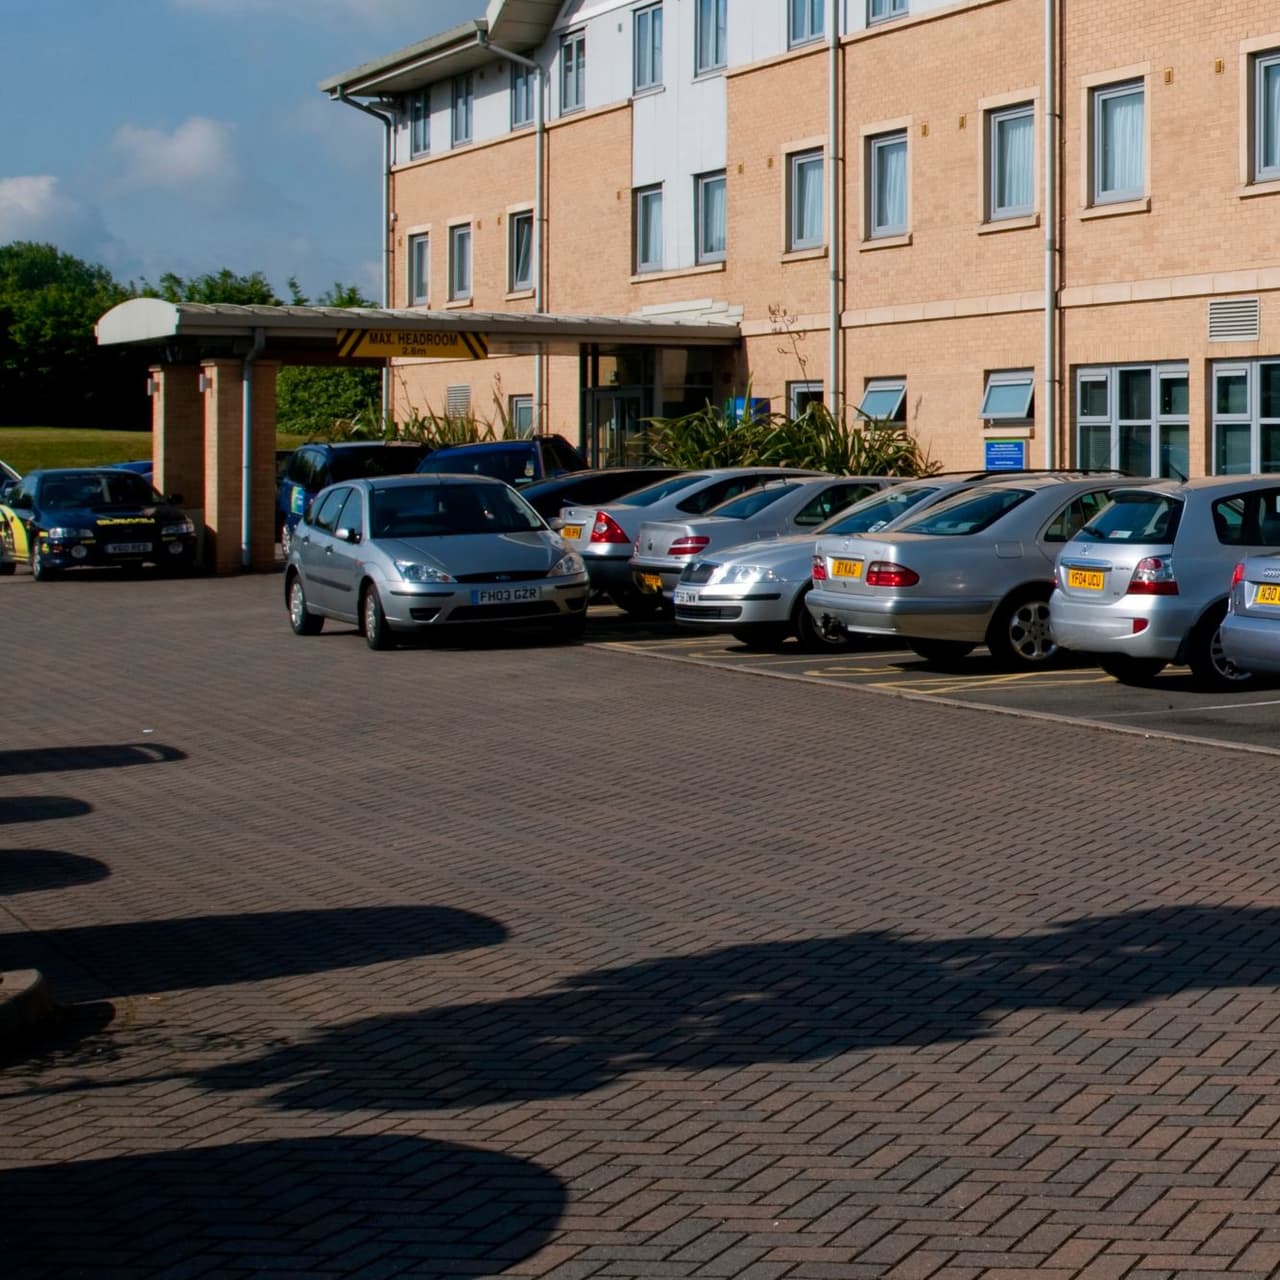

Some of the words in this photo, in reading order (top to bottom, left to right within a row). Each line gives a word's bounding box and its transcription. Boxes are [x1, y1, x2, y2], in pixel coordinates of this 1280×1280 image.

[369, 332, 395, 345] MAX.
[398, 331, 459, 346] HEADROOM
[480, 590, 511, 602] FH03
[514, 588, 537, 600] GZR
[1261, 586, 1277, 601] N30
